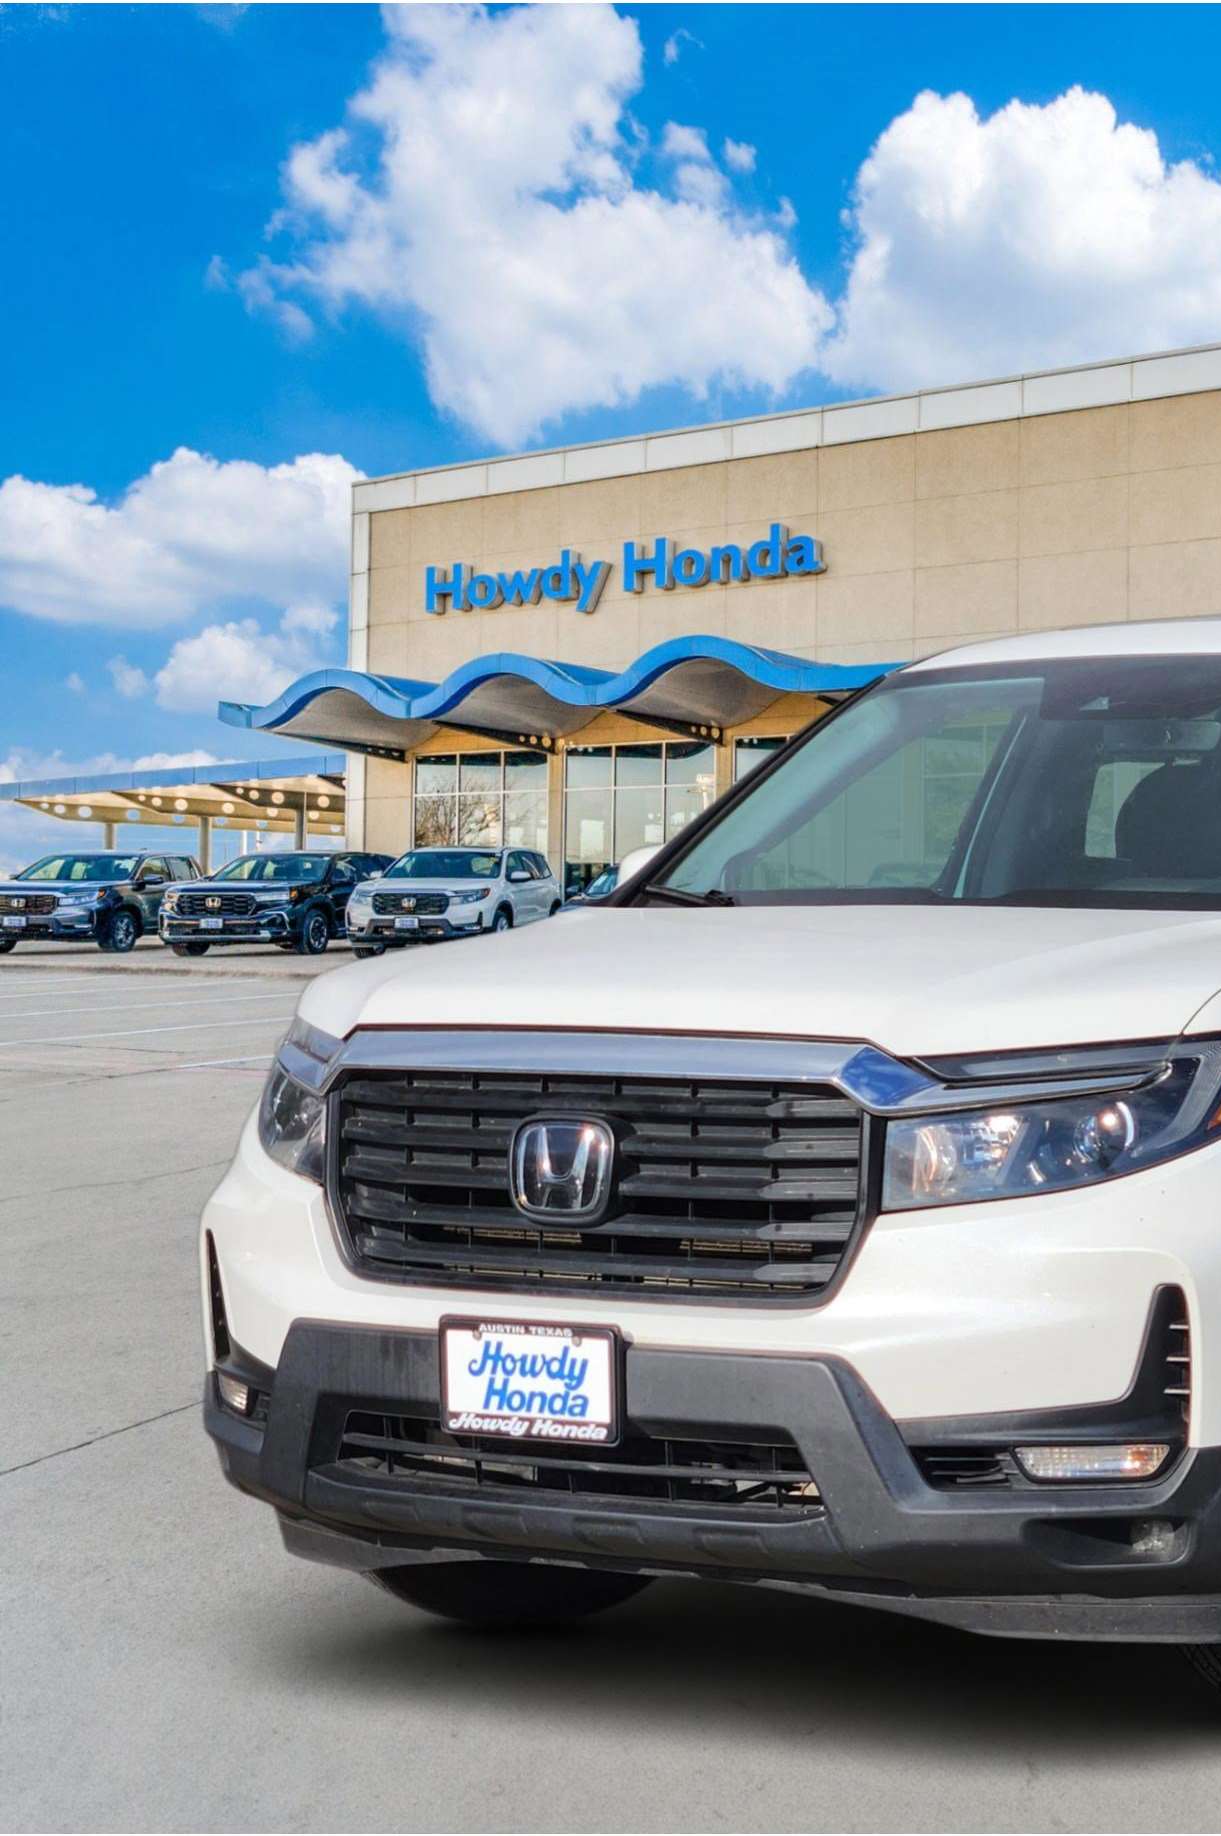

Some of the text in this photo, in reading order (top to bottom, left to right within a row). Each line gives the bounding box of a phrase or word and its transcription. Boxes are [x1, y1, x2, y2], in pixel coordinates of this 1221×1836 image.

[425, 523, 826, 614] Howdy Honda
[479, 1323, 573, 1338] AUSTIN TEXAS
[468, 1340, 589, 1391] Howdy
[483, 1377, 589, 1417] Honda
[449, 1412, 608, 1441] Howdy Honda
